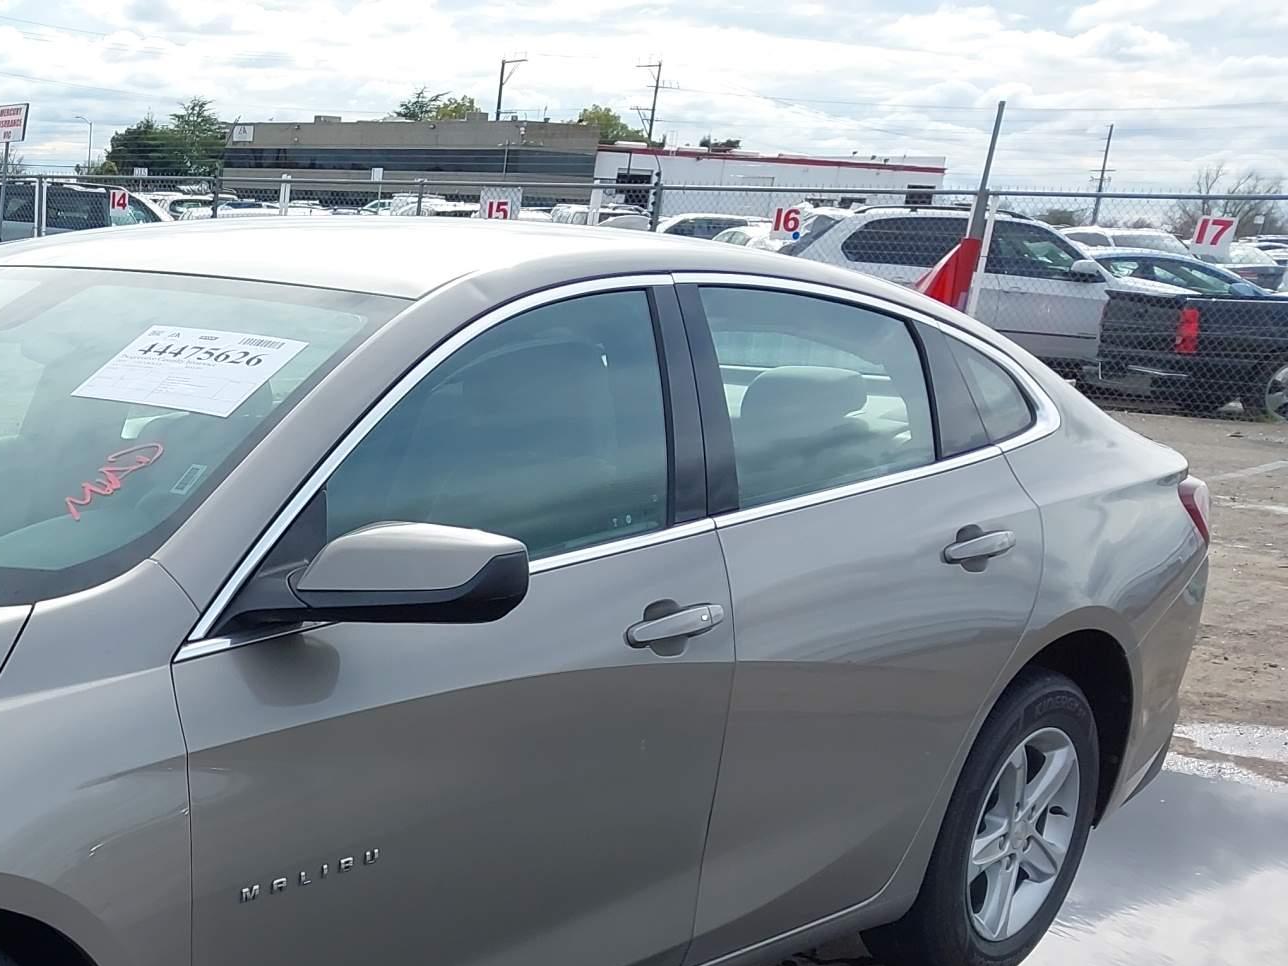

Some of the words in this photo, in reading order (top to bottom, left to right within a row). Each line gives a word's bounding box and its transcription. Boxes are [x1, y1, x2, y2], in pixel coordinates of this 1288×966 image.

[111, 192, 127, 210] 14
[487, 201, 509, 219] 15
[774, 208, 800, 232] 16
[1195, 218, 1234, 245] 17
[138, 342, 267, 367] 44475626
[240, 848, 379, 903] MALIBU
